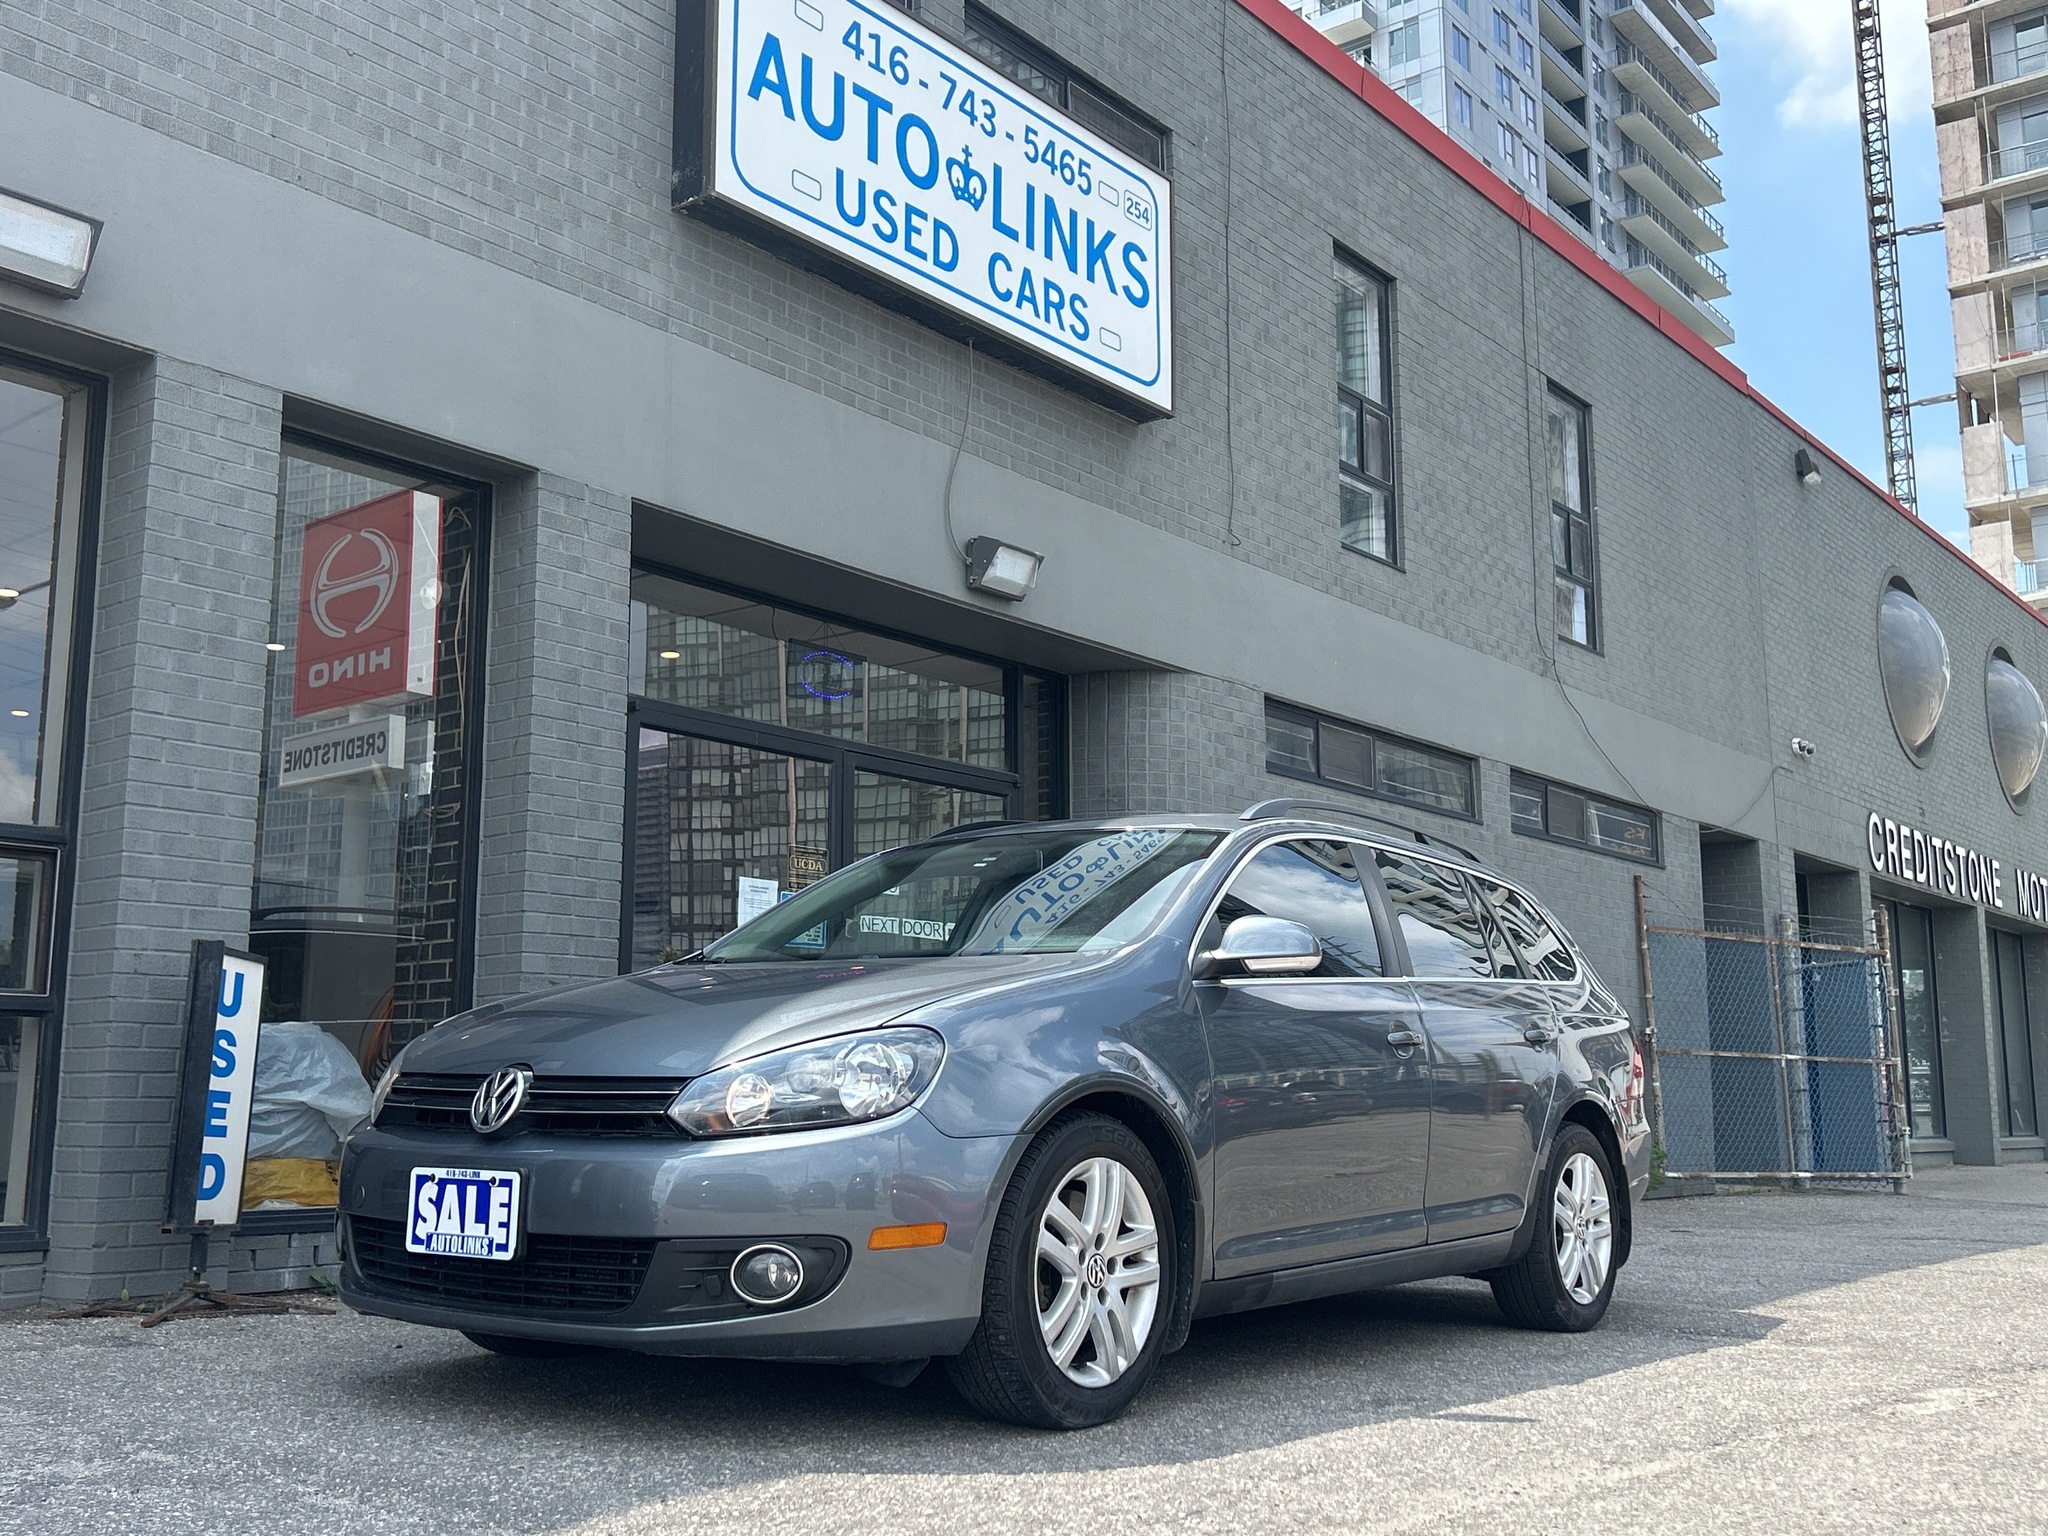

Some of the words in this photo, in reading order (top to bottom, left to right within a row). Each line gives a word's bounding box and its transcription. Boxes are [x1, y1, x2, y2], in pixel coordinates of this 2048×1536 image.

[747, 32, 940, 190] AUTO
[992, 162, 1150, 308] LINKS
[1126, 197, 1150, 224] 254
[835, 167, 959, 273] USED
[988, 252, 1090, 341] CARS
[794, 858, 823, 872] UCDA
[1868, 812, 2003, 908] CREDITSTONE
[861, 917, 898, 932] NEXT
[903, 920, 942, 938] DOOR
[197, 968, 245, 1201] USED
[415, 1181, 509, 1244] SALE
[430, 1235, 489, 1256] AUTOLINKS
